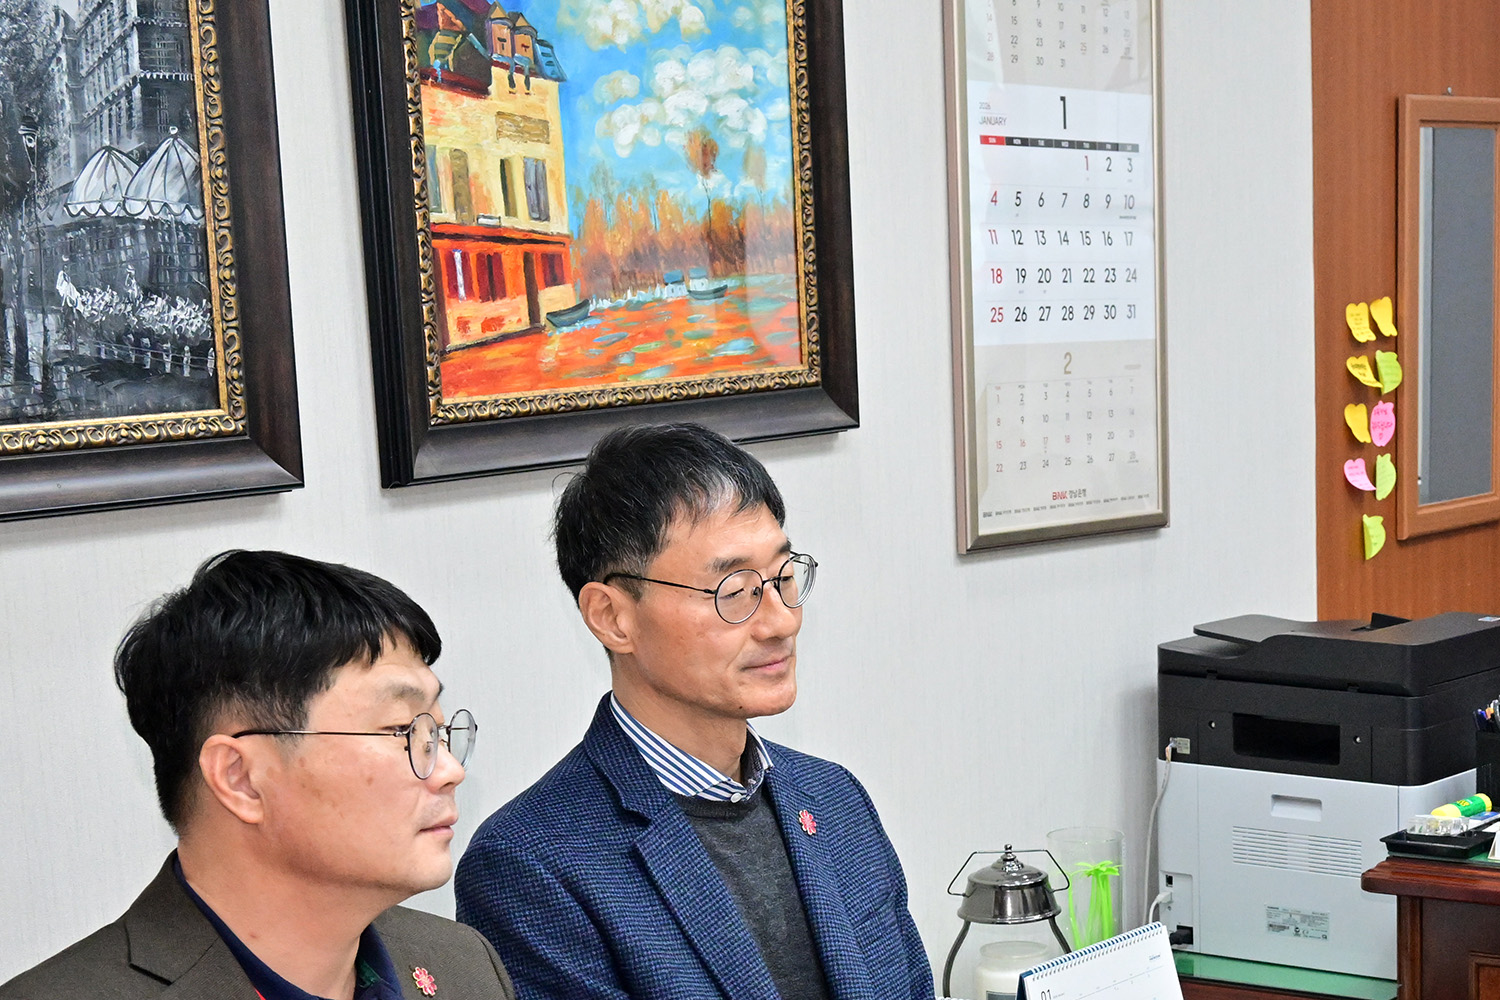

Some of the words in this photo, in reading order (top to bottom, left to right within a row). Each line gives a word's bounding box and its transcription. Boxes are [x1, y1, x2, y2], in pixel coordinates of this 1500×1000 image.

[979, 116, 1007, 126] JANUARY
[1060, 96, 1067, 129] 1
[1084, 155, 1089, 171] 1
[1106, 156, 1112, 172] 2
[1127, 158, 1133, 173] 3
[990, 190, 998, 207] 4
[1015, 191, 1022, 207] 5
[1038, 192, 1045, 208] 6
[1062, 192, 1068, 208] 7
[1083, 193, 1090, 209] 8
[1105, 194, 1111, 209] 9
[1124, 194, 1135, 210] 10
[988, 229, 998, 245] 11
[1011, 230, 1024, 245] 12
[1035, 230, 1047, 246] 13
[1058, 230, 1069, 246] 14
[1080, 230, 1091, 246] 15
[1102, 231, 1113, 246] 16
[1124, 231, 1133, 246] 17
[990, 268, 1003, 284] 18
[1015, 268, 1027, 284] 19
[1037, 268, 1051, 284] 20
[1062, 268, 1072, 284] 21
[1083, 268, 1095, 283] 22
[1104, 268, 1117, 283] 23
[1125, 267, 1137, 283] 24
[990, 307, 1004, 323] 25
[1014, 306, 1028, 322] 26
[1038, 306, 1051, 322] 27
[1061, 305, 1074, 321] 28
[1083, 305, 1095, 320] 29
[1103, 304, 1117, 320] 30
[1126, 304, 1136, 319] 31
[1063, 352, 1072, 375] 2
[996, 464, 1003, 472] 22
[1020, 461, 1027, 470] 23
[1042, 459, 1049, 468] 24
[1064, 457, 1072, 466] 25
[1086, 455, 1093, 464] 26
[1108, 453, 1115, 461] 27
[1052, 491, 1068, 501] BNK
